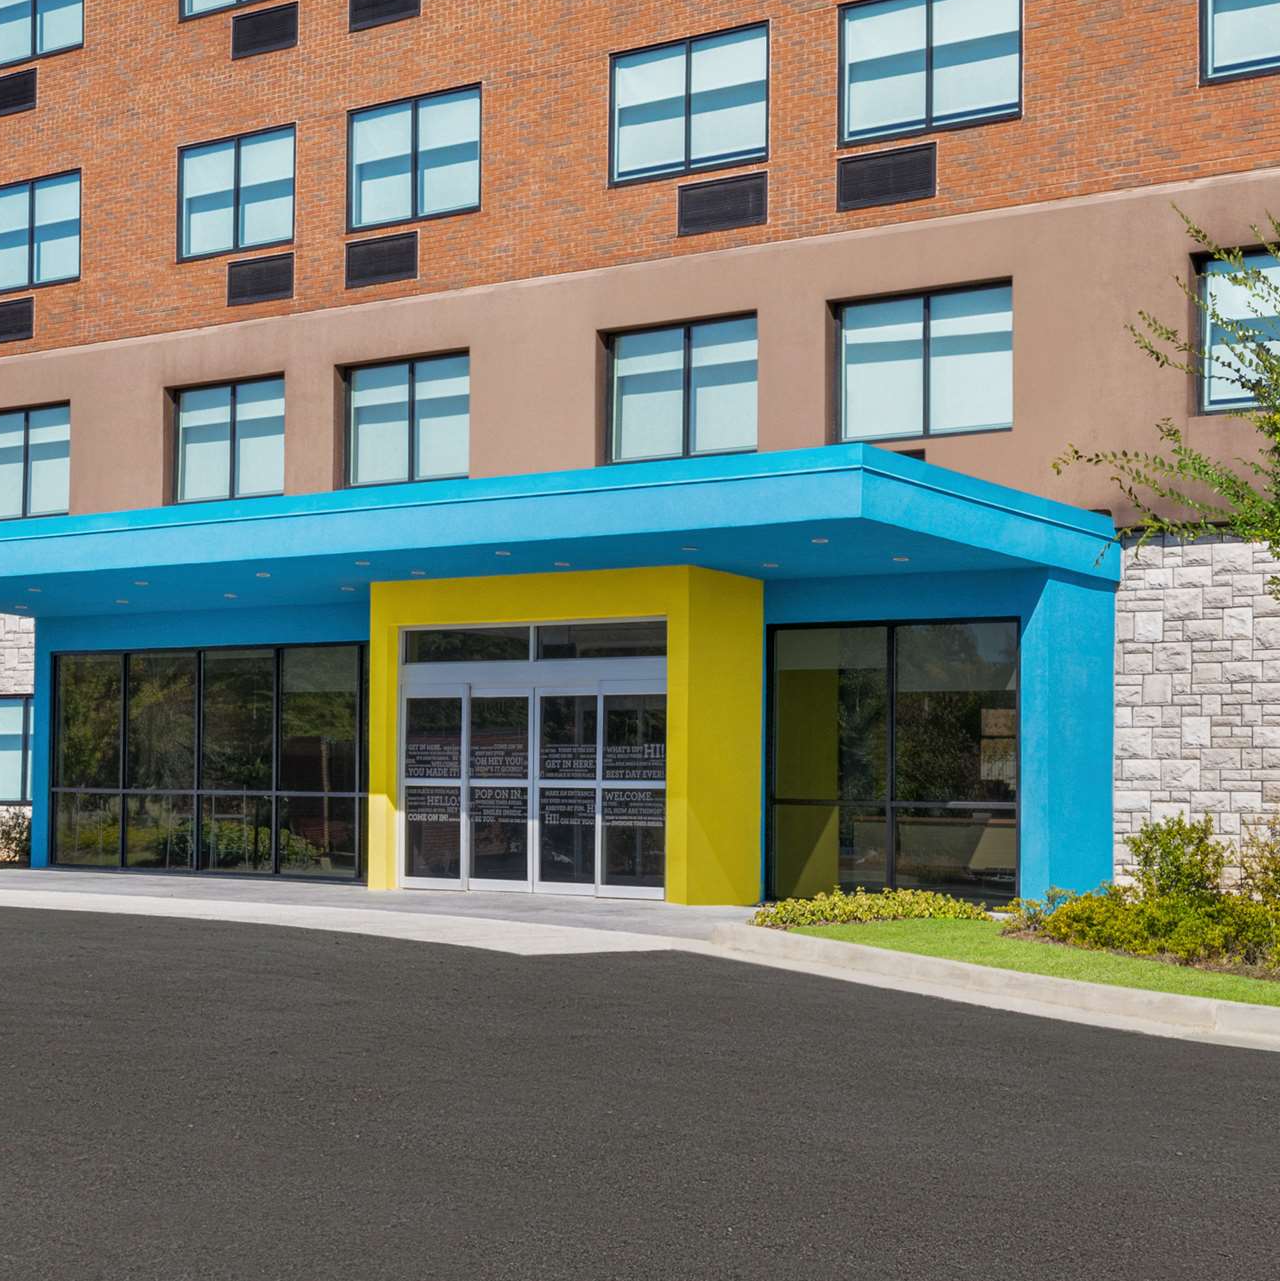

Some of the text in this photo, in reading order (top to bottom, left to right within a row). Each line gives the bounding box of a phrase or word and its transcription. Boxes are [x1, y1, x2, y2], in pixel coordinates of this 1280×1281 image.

[644, 744, 665, 758] HI!
[476, 757, 487, 766] OH
[488, 757, 504, 766] HEY
[545, 760, 561, 769] GET
[562, 760, 572, 769] IN
[408, 768, 425, 777] YOU
[426, 768, 448, 777] MADE
[606, 770, 624, 778] BEST
[625, 770, 641, 778] DAY
[475, 789, 493, 799] POP
[495, 789, 509, 799] ON
[427, 796, 459, 806] HELLO.
[408, 813, 427, 821] COME
[428, 813, 438, 821] ON
[545, 813, 560, 824] HI!
